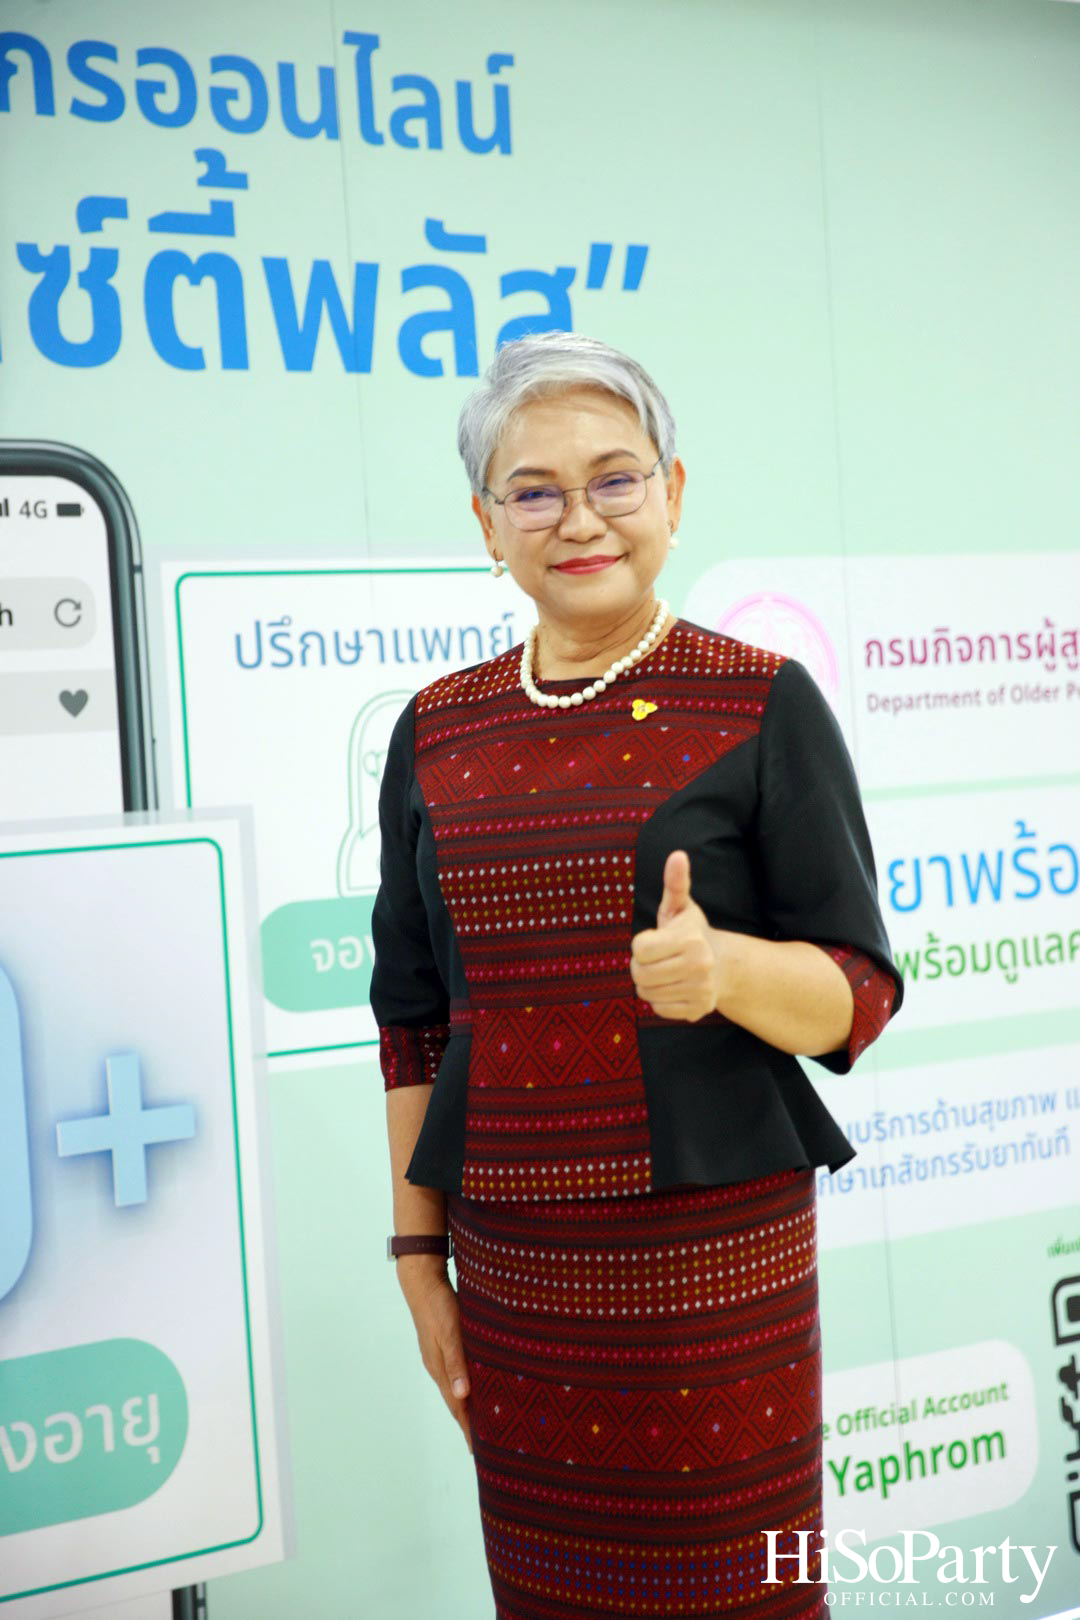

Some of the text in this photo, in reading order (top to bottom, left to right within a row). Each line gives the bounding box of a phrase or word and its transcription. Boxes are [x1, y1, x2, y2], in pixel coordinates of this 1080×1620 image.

[0, 31, 515, 155] กรออนไลน์
[19, 500, 47, 519] 4G
[235, 612, 514, 669] ปรึกษาแพทย์
[867, 689, 981, 716] Department
[987, 683, 1006, 706] of
[1010, 682, 1060, 704] Older
[888, 820, 1080, 913] ยาพร้อ
[836, 1397, 918, 1437] Official
[922, 1382, 1009, 1418] Account
[828, 1430, 1006, 1499] Yaphrom
